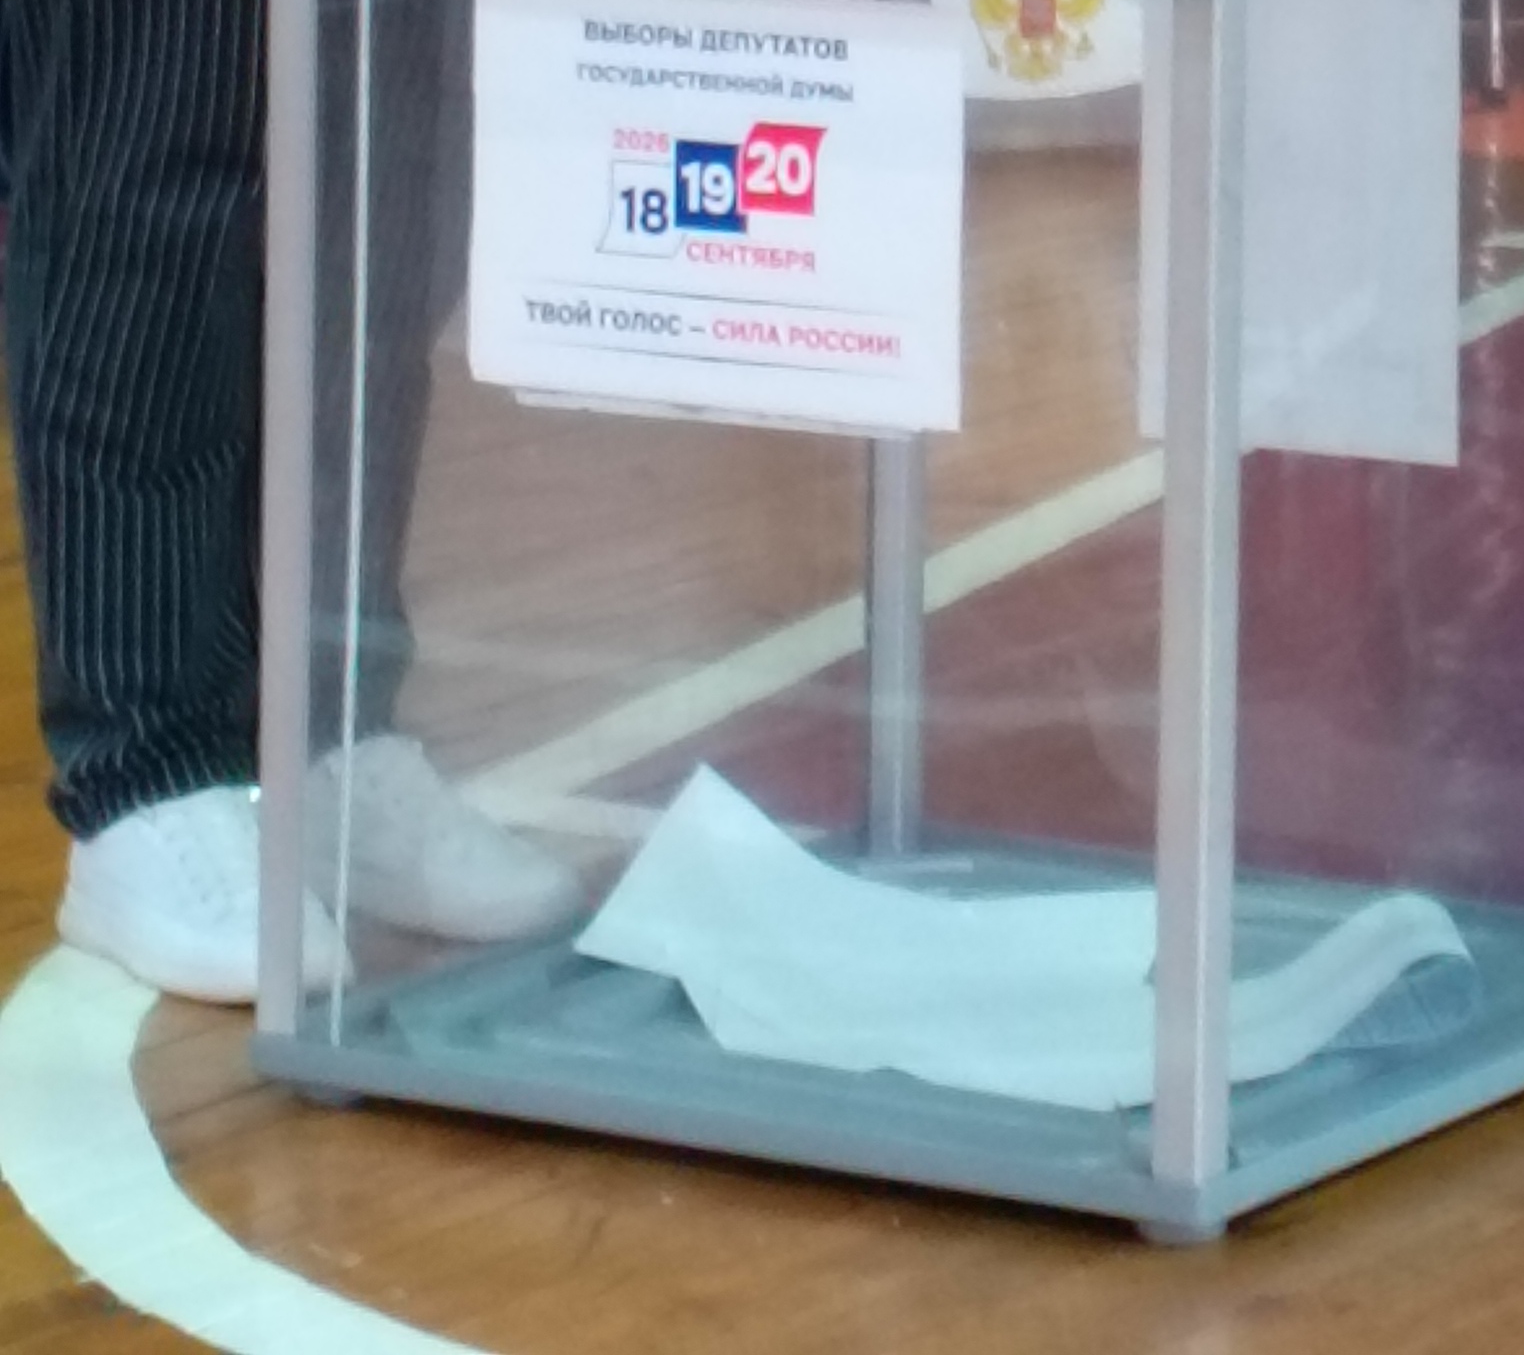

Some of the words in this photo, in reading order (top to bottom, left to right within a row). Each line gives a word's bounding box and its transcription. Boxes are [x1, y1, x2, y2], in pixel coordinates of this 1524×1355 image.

[584, 20, 693, 49] ВЫБОРЫ
[700, 29, 849, 61] ДЕПУТАТОВ
[577, 63, 785, 97] ГОСУДАРСТВЕННОЙ
[790, 81, 854, 102] ДУМЫ
[613, 128, 670, 152] 2026
[620, 188, 669, 234] 18
[680, 161, 735, 215] 19
[745, 141, 812, 194] 20
[686, 242, 817, 272] СЕНТЯБРЯ
[525, 299, 593, 327] ТВОЙ
[599, 308, 682, 336] ГОЛОС
[712, 322, 781, 347] СИЛА
[788, 328, 901, 359] РОССИИ!
